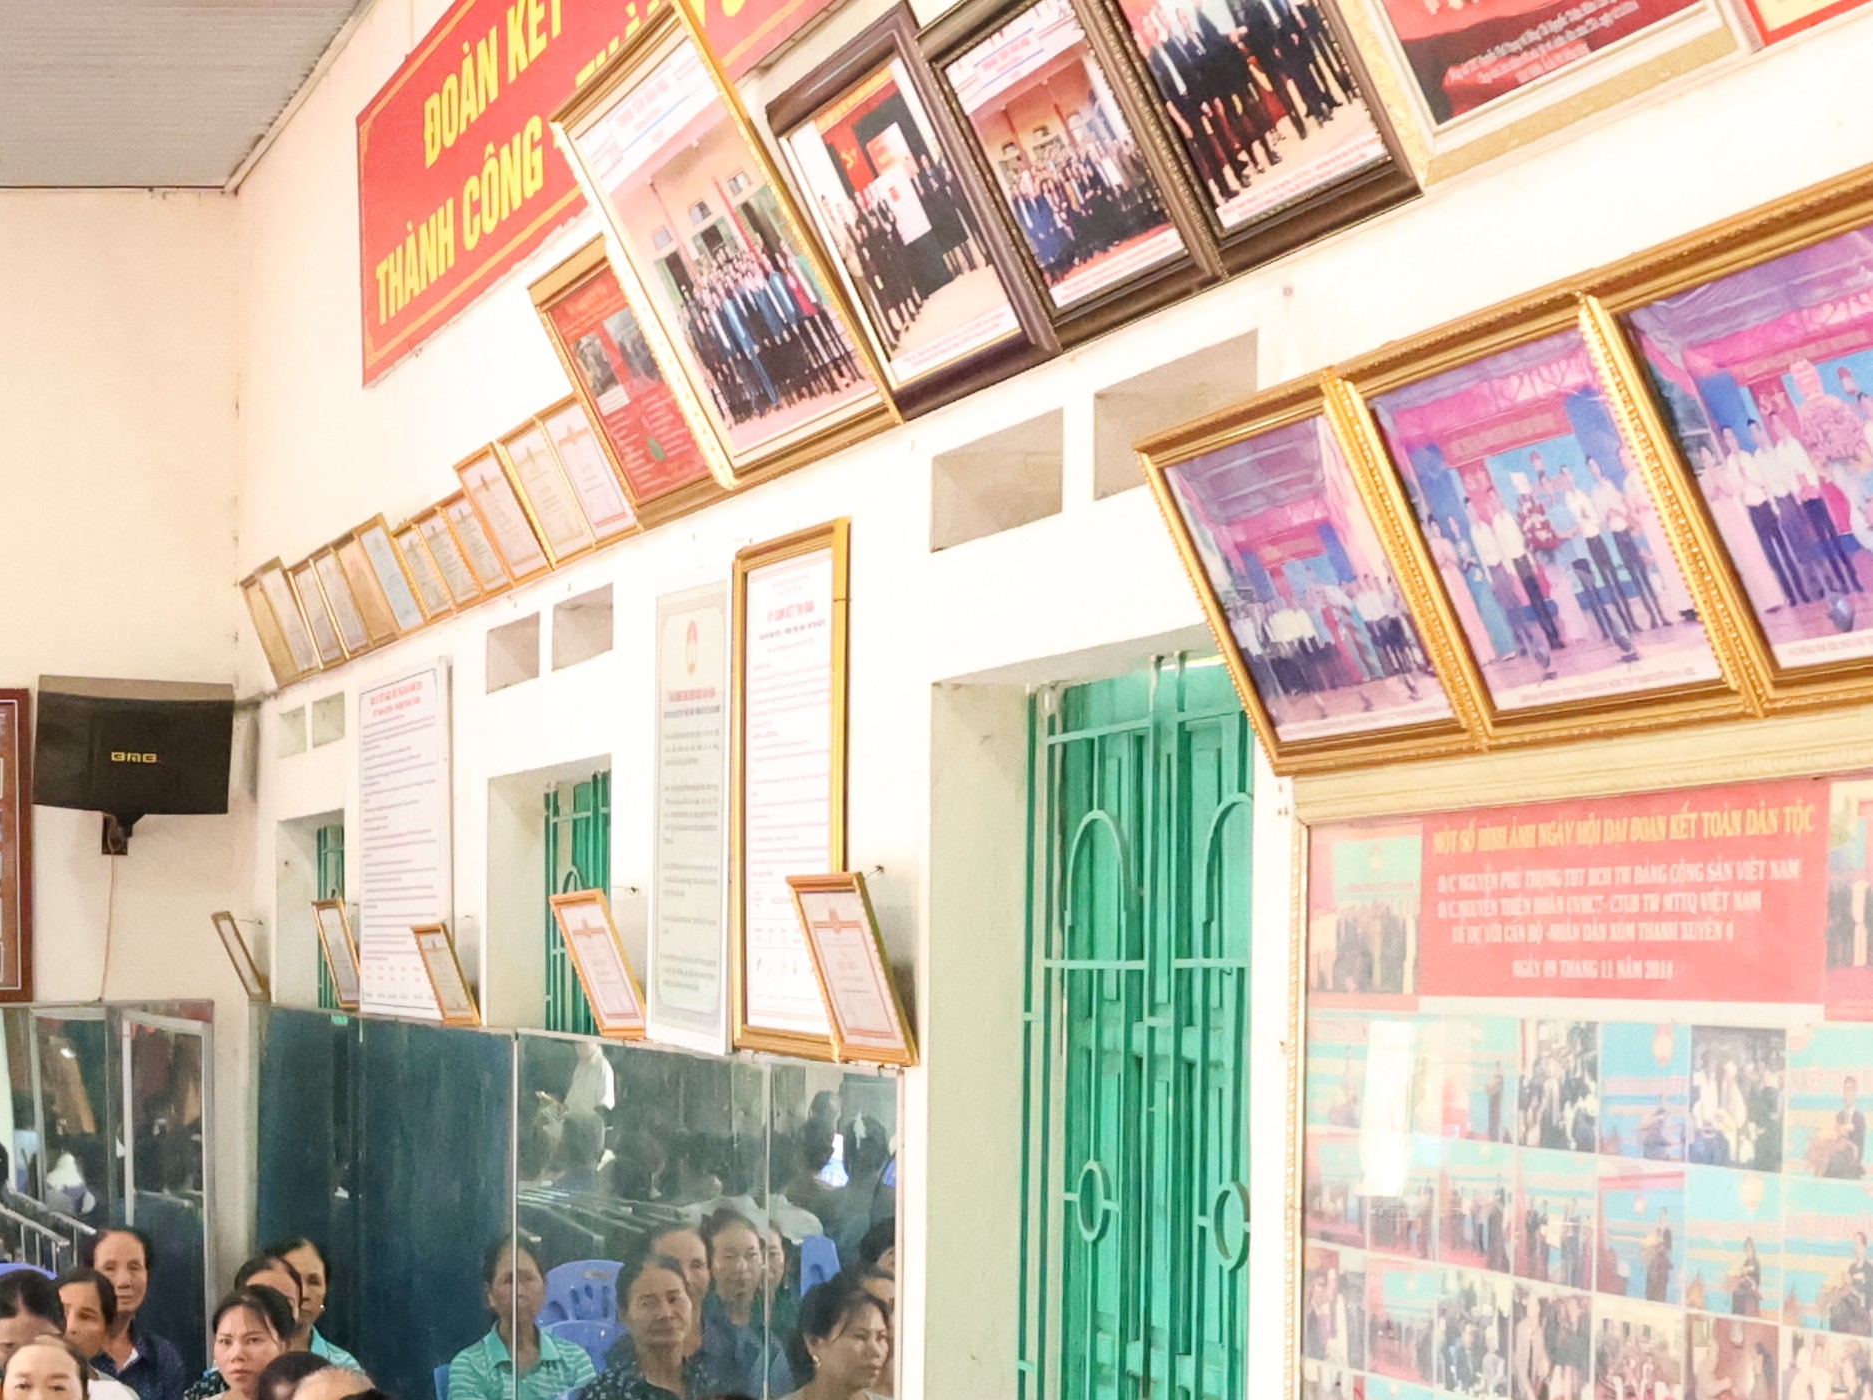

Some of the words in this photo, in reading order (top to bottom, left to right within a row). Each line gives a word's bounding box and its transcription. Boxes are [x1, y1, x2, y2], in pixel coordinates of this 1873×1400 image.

[424, 25, 498, 169] ĐOÀN
[376, 197, 455, 326] THÀNH
[463, 115, 543, 250] CÔNG
[1670, 800, 1698, 839] KẾT
[1783, 798, 1816, 837] TỘC
[1735, 854, 1767, 882] VIỆT
[1768, 859, 1801, 880] NAM
